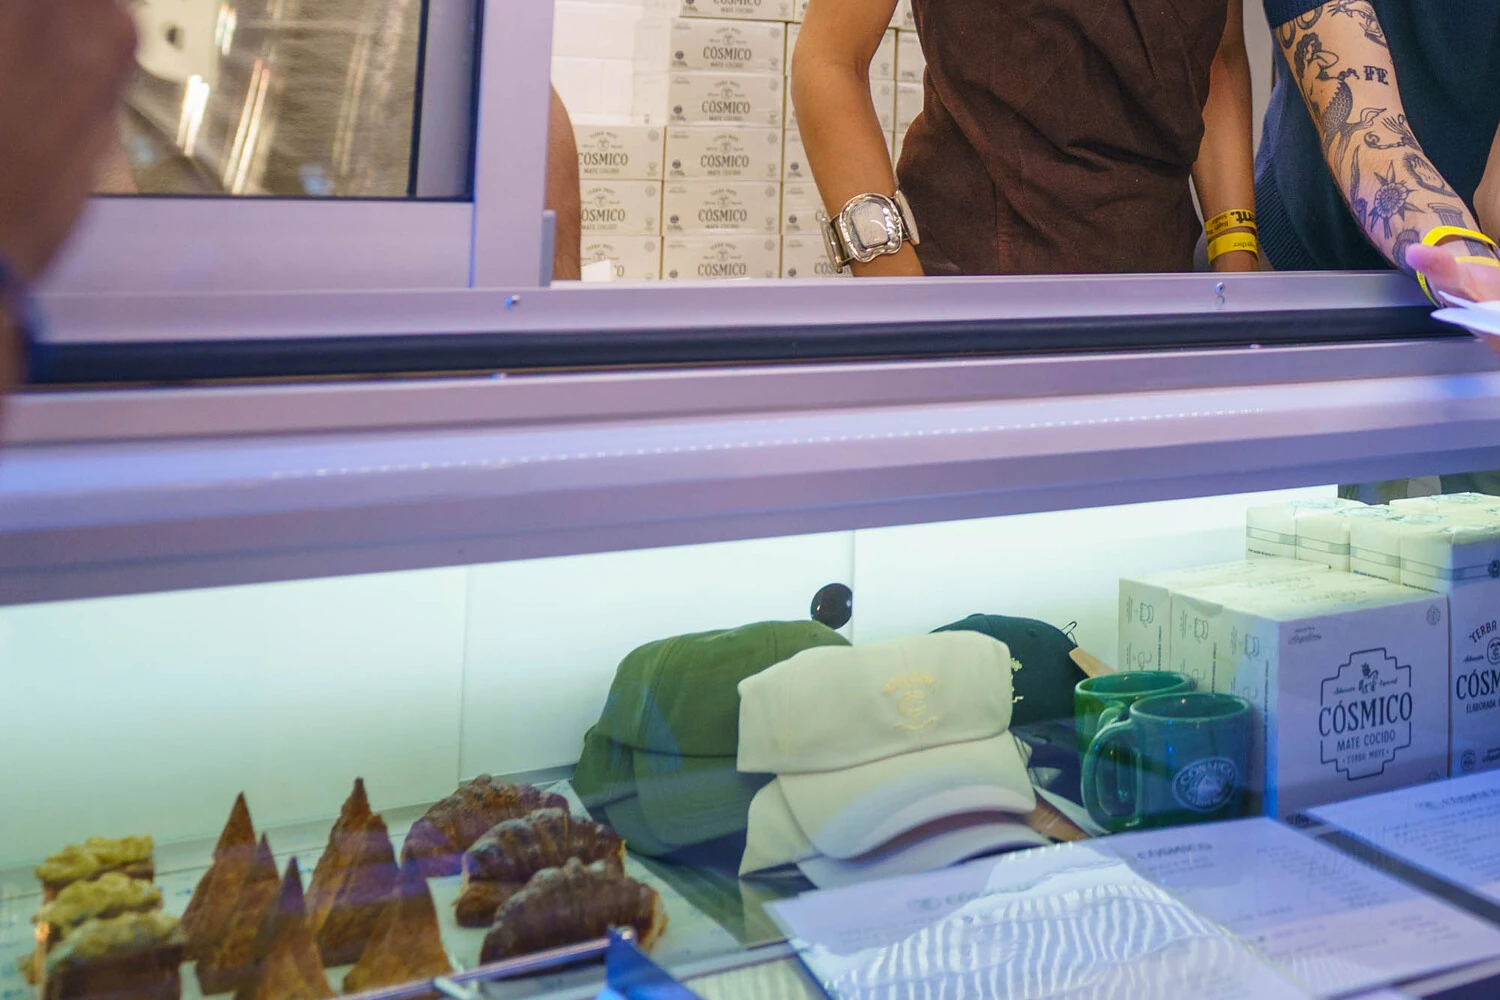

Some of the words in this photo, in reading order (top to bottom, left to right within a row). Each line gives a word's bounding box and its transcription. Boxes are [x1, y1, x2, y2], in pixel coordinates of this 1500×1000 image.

[1318, 691, 1413, 737] CÓSMICO
[1336, 735, 1360, 752] MATE
[1364, 729, 1395, 746] COCIDO
